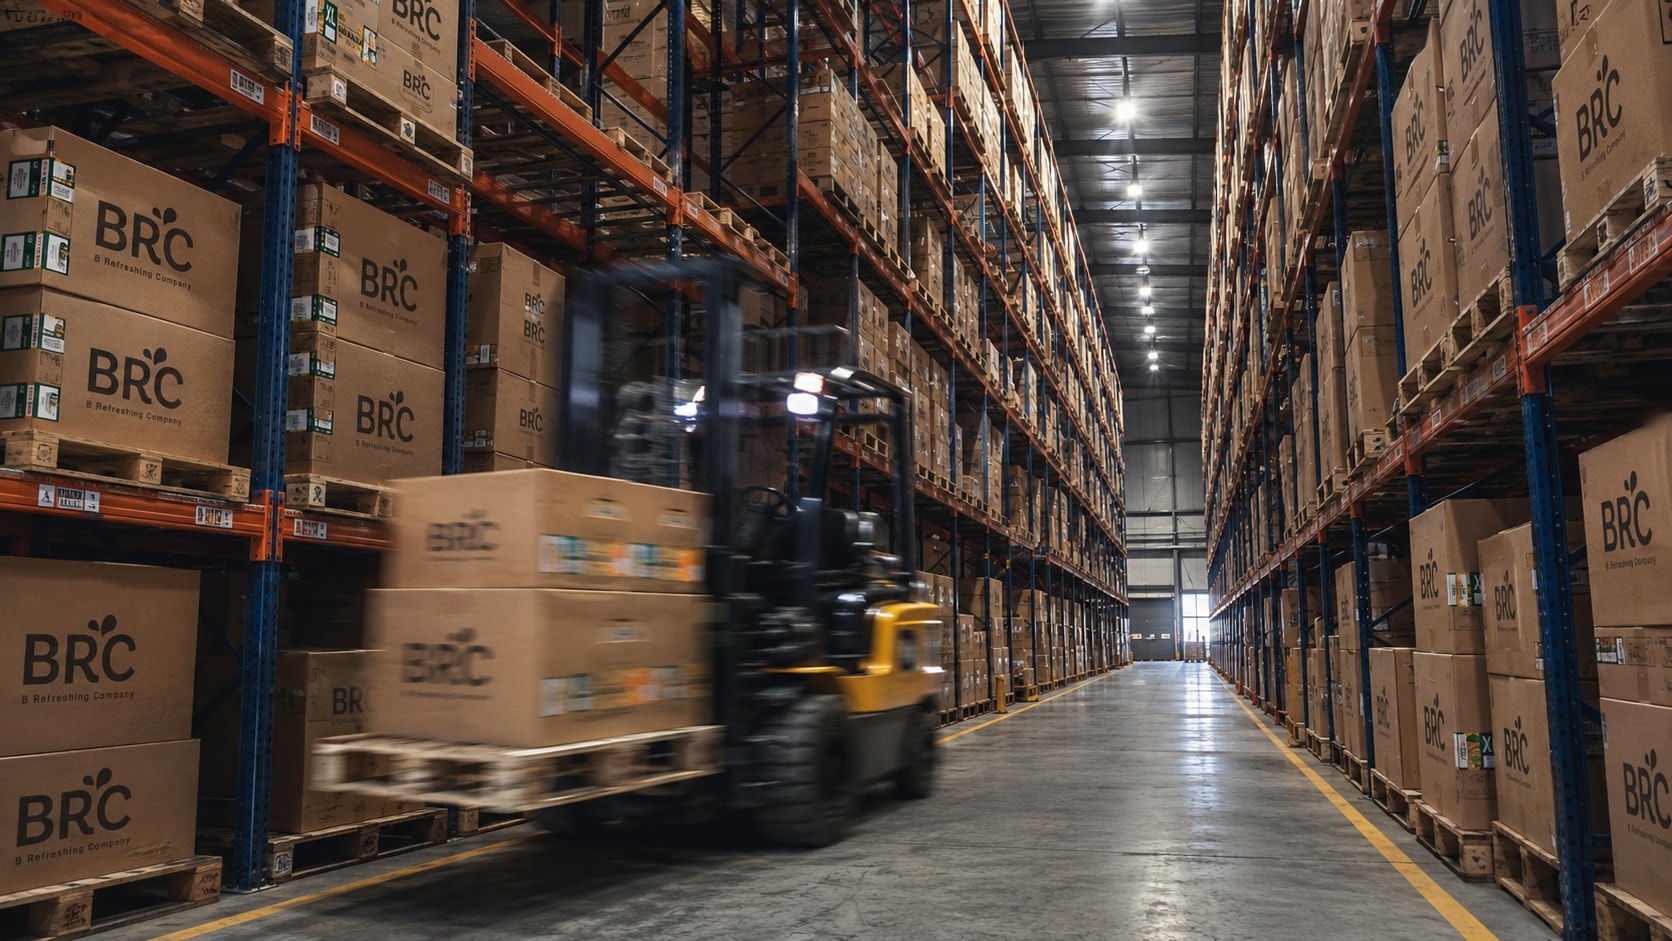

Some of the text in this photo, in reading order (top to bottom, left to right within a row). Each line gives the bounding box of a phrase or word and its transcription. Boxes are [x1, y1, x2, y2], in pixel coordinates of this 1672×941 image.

[325, 5, 336, 27] XL
[392, 0, 442, 42] BRC
[1460, 9, 1484, 84] BRC
[403, 69, 431, 101] BRC
[1405, 100, 1426, 166] BRC
[1576, 69, 1623, 163] BRC
[1468, 177, 1492, 241] BRC
[95, 199, 194, 273] BRC
[104, 257, 153, 279] Refreshing
[156, 272, 192, 291] Company
[360, 256, 418, 313] BRC
[1411, 249, 1433, 308] BRC
[525, 292, 545, 314] BRC
[523, 319, 545, 344] BRC
[87, 347, 184, 410] BRC
[95, 402, 143, 419] Refreshing
[146, 411, 182, 426] Company
[356, 394, 415, 443] BRC
[520, 408, 543, 432] BRC
[1601, 490, 1653, 553] BRC
[1420, 560, 1439, 600] BRC
[1495, 584, 1516, 621] BRC
[23, 633, 137, 686] BRC
[33, 692, 89, 704] Refreshing
[93, 690, 135, 701] Company
[1424, 705, 1446, 752] BRC
[1503, 727, 1530, 775] BRC
[16, 784, 132, 848] BRC
[1623, 762, 1672, 830] BRC
[27, 846, 84, 864] Refreshing
[88, 837, 131, 852] Company
